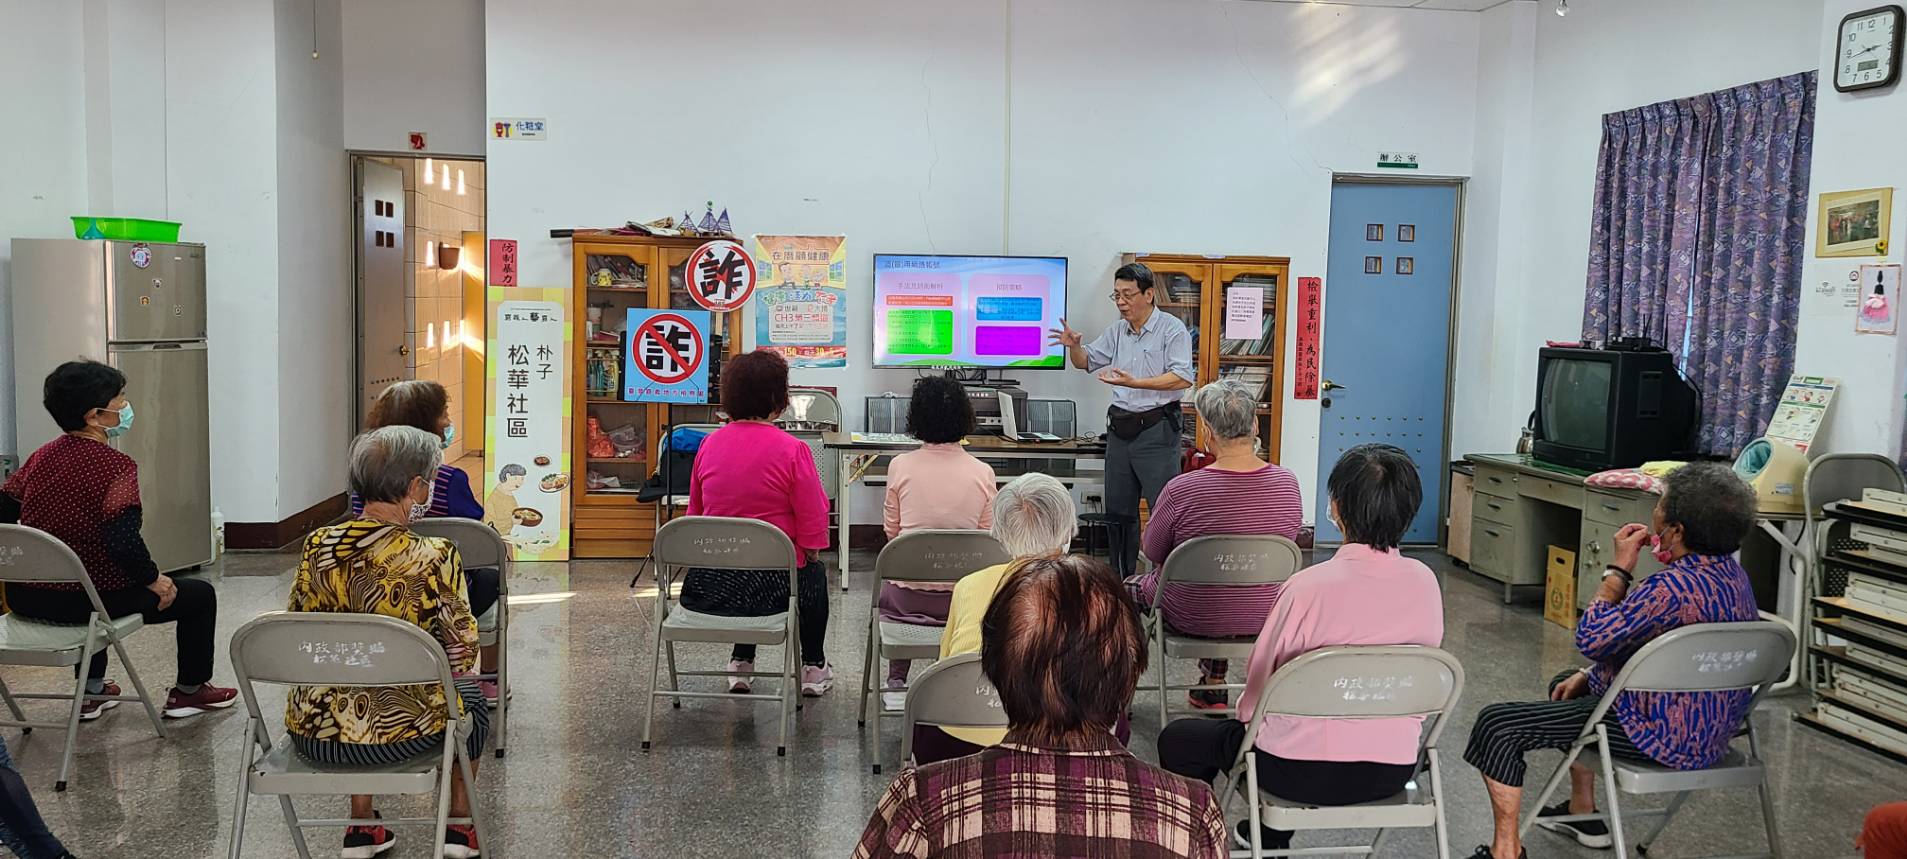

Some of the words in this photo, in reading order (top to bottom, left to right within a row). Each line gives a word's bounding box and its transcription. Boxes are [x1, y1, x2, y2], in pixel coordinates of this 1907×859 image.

[1857, 22, 1864, 30] 11
[1868, 19, 1876, 28] 12
[1848, 33, 1856, 41] 10
[1846, 49, 1852, 59] 9
[1844, 65, 1851, 73] 8
[1876, 69, 1882, 78] 5
[1853, 73, 1858, 82] 7
[1864, 72, 1870, 80] 6
[502, 243, 514, 287] 防制暴力
[698, 249, 746, 300] 詐
[536, 344, 553, 380] 朴子
[507, 344, 529, 438] 松華社區
